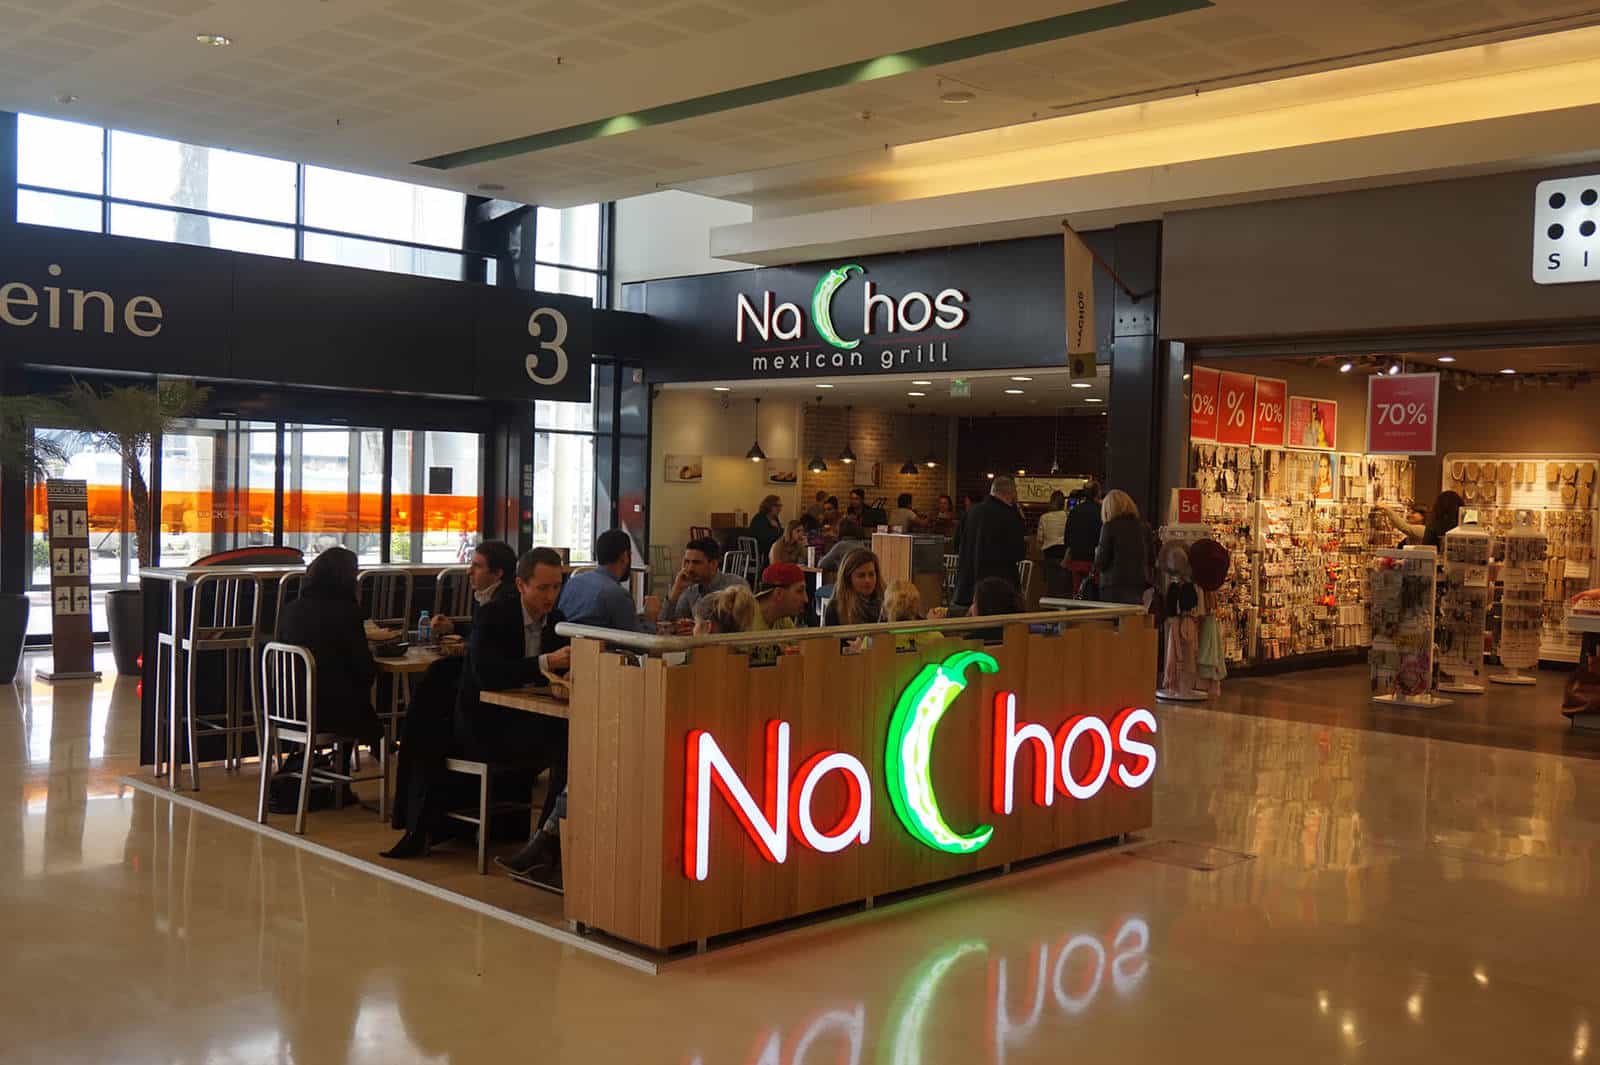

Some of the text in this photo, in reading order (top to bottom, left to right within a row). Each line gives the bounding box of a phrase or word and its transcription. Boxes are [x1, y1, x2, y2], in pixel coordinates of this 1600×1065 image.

[0, 264, 163, 337] eine
[526, 307, 568, 385] 3
[752, 342, 948, 371] mexican grill
[1259, 402, 1283, 423] 70%
[1376, 403, 1427, 425] 70%
[683, 650, 1158, 881] NaChos
